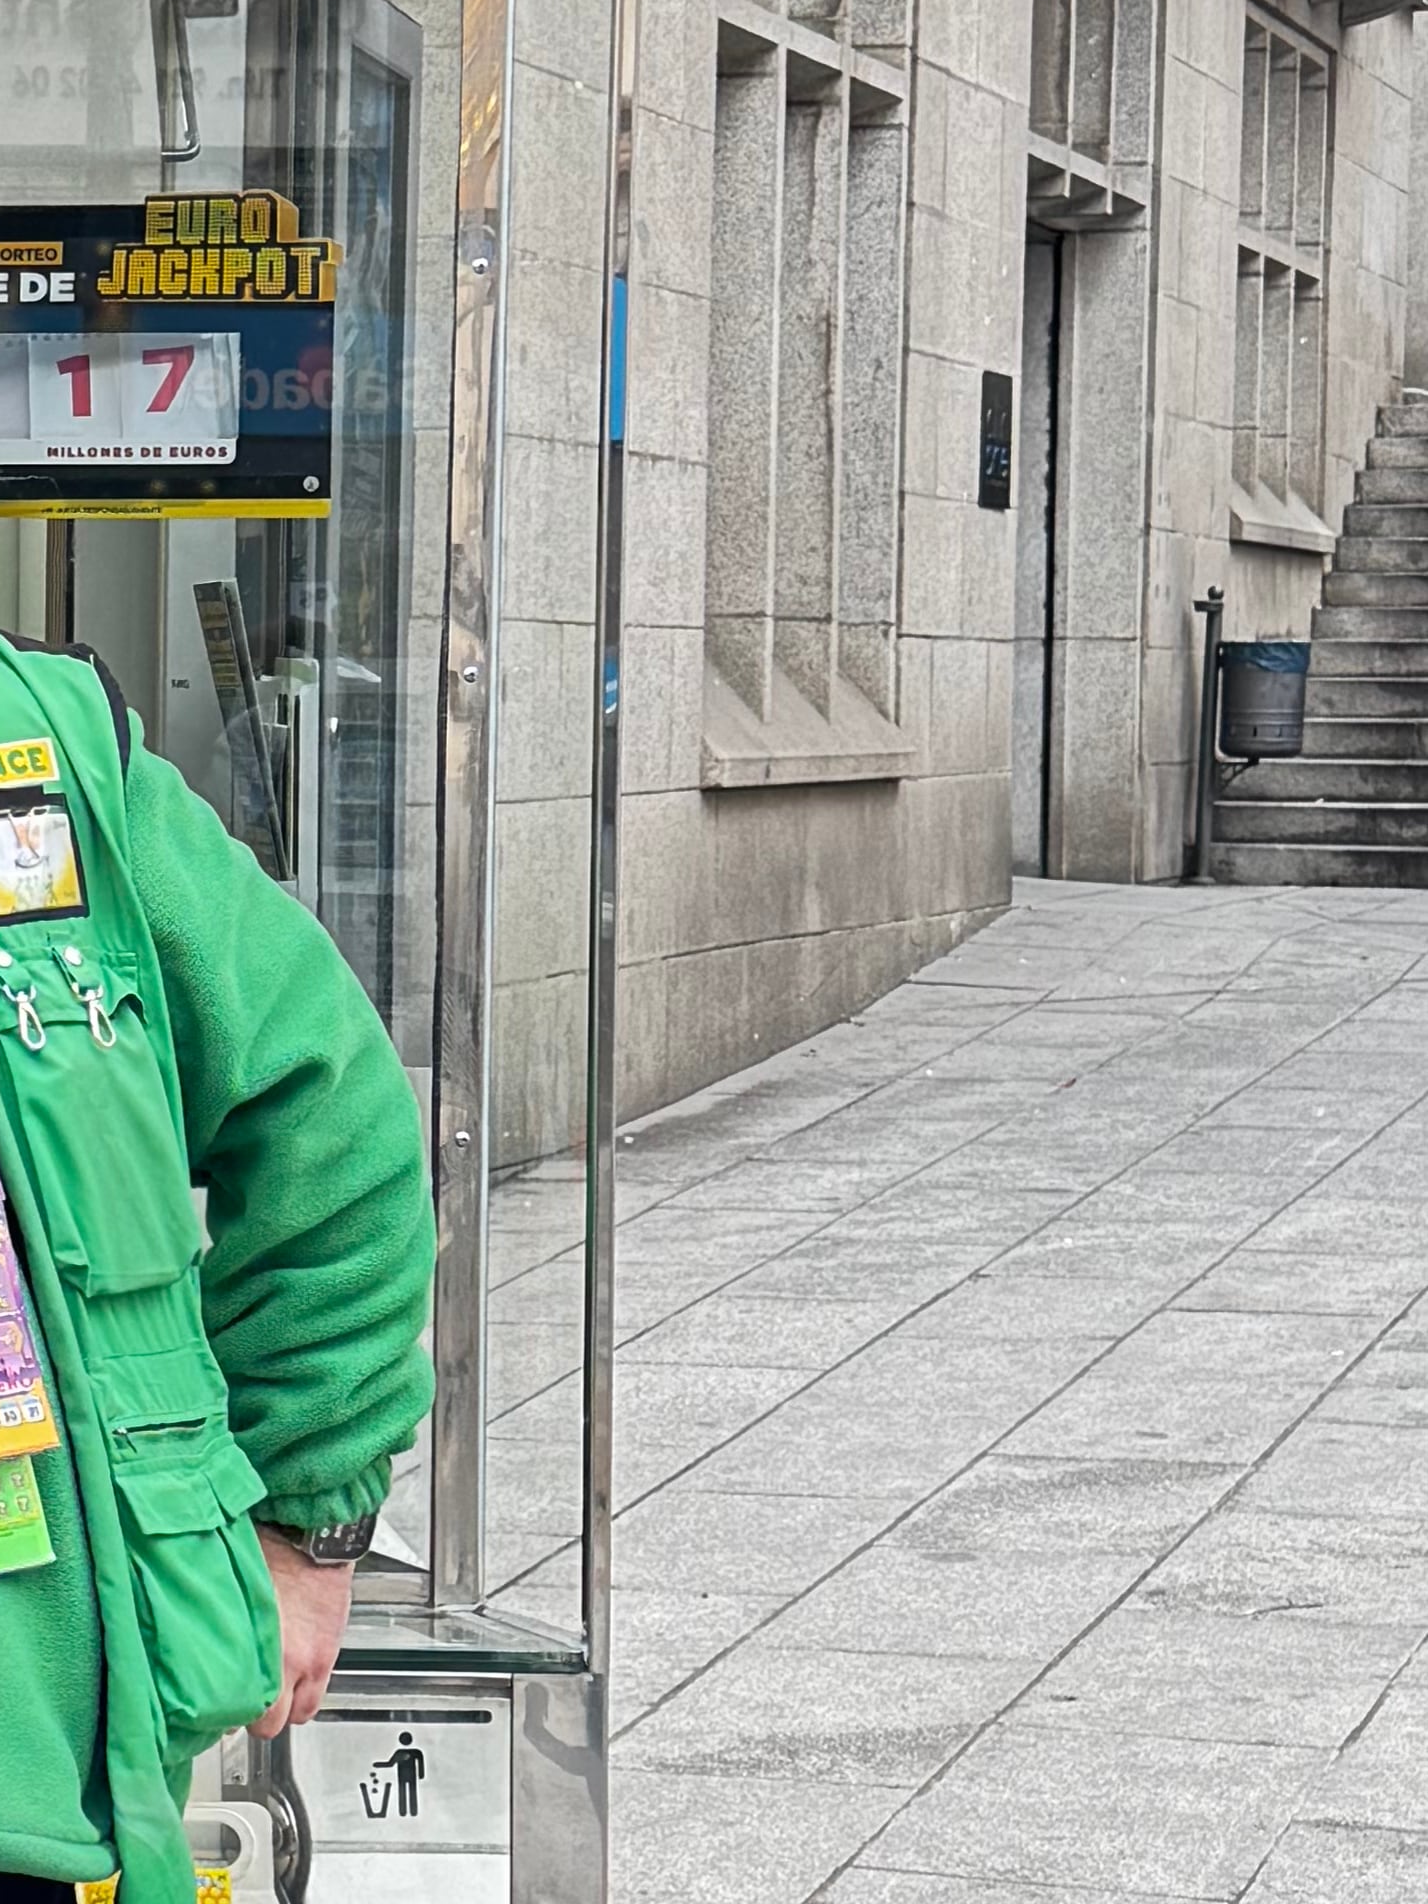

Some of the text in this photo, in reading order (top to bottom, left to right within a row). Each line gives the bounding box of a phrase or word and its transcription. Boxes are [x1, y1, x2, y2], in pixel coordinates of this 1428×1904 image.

[145, 197, 272, 245] EURO
[19, 272, 77, 303] DE
[96, 246, 322, 297] JACKPOT
[46, 446, 229, 458] MILLONES DE EUROS
